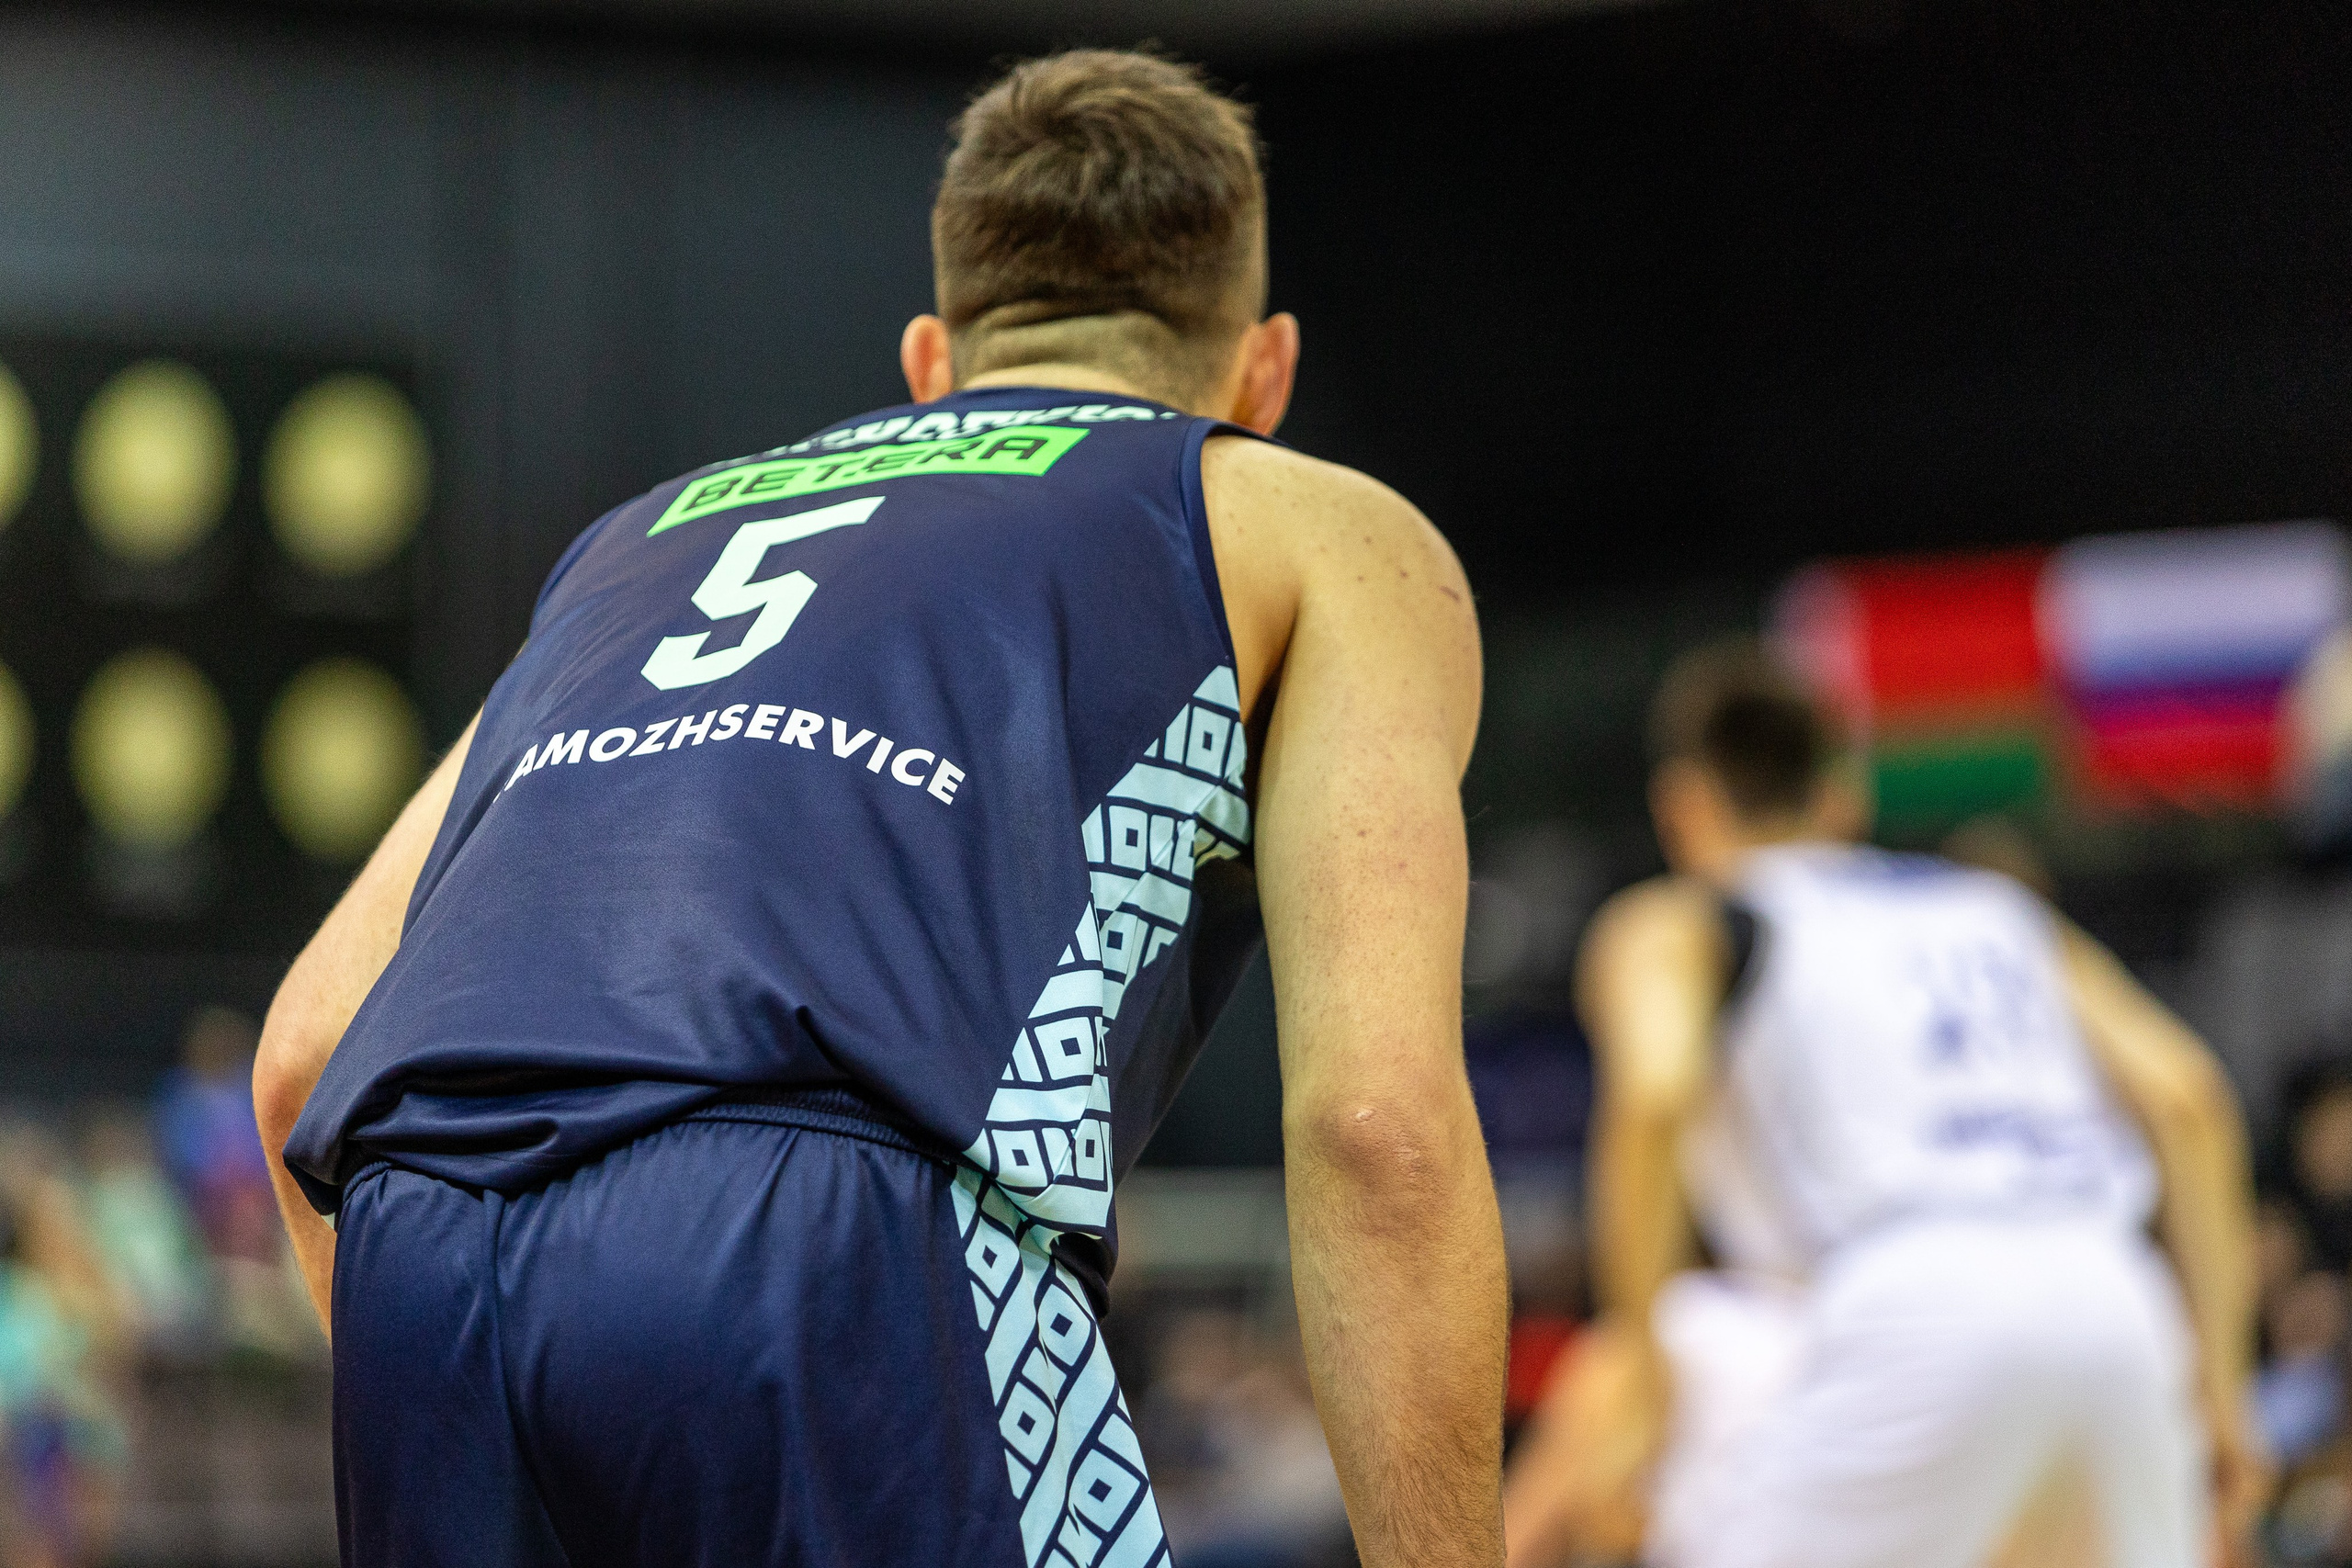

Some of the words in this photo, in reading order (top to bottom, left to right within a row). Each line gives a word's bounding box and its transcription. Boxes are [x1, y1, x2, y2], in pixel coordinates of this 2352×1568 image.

[684, 435, 1051, 512] BETERA
[641, 496, 886, 691] 5
[493, 704, 966, 806] AMOZHSERVICE
